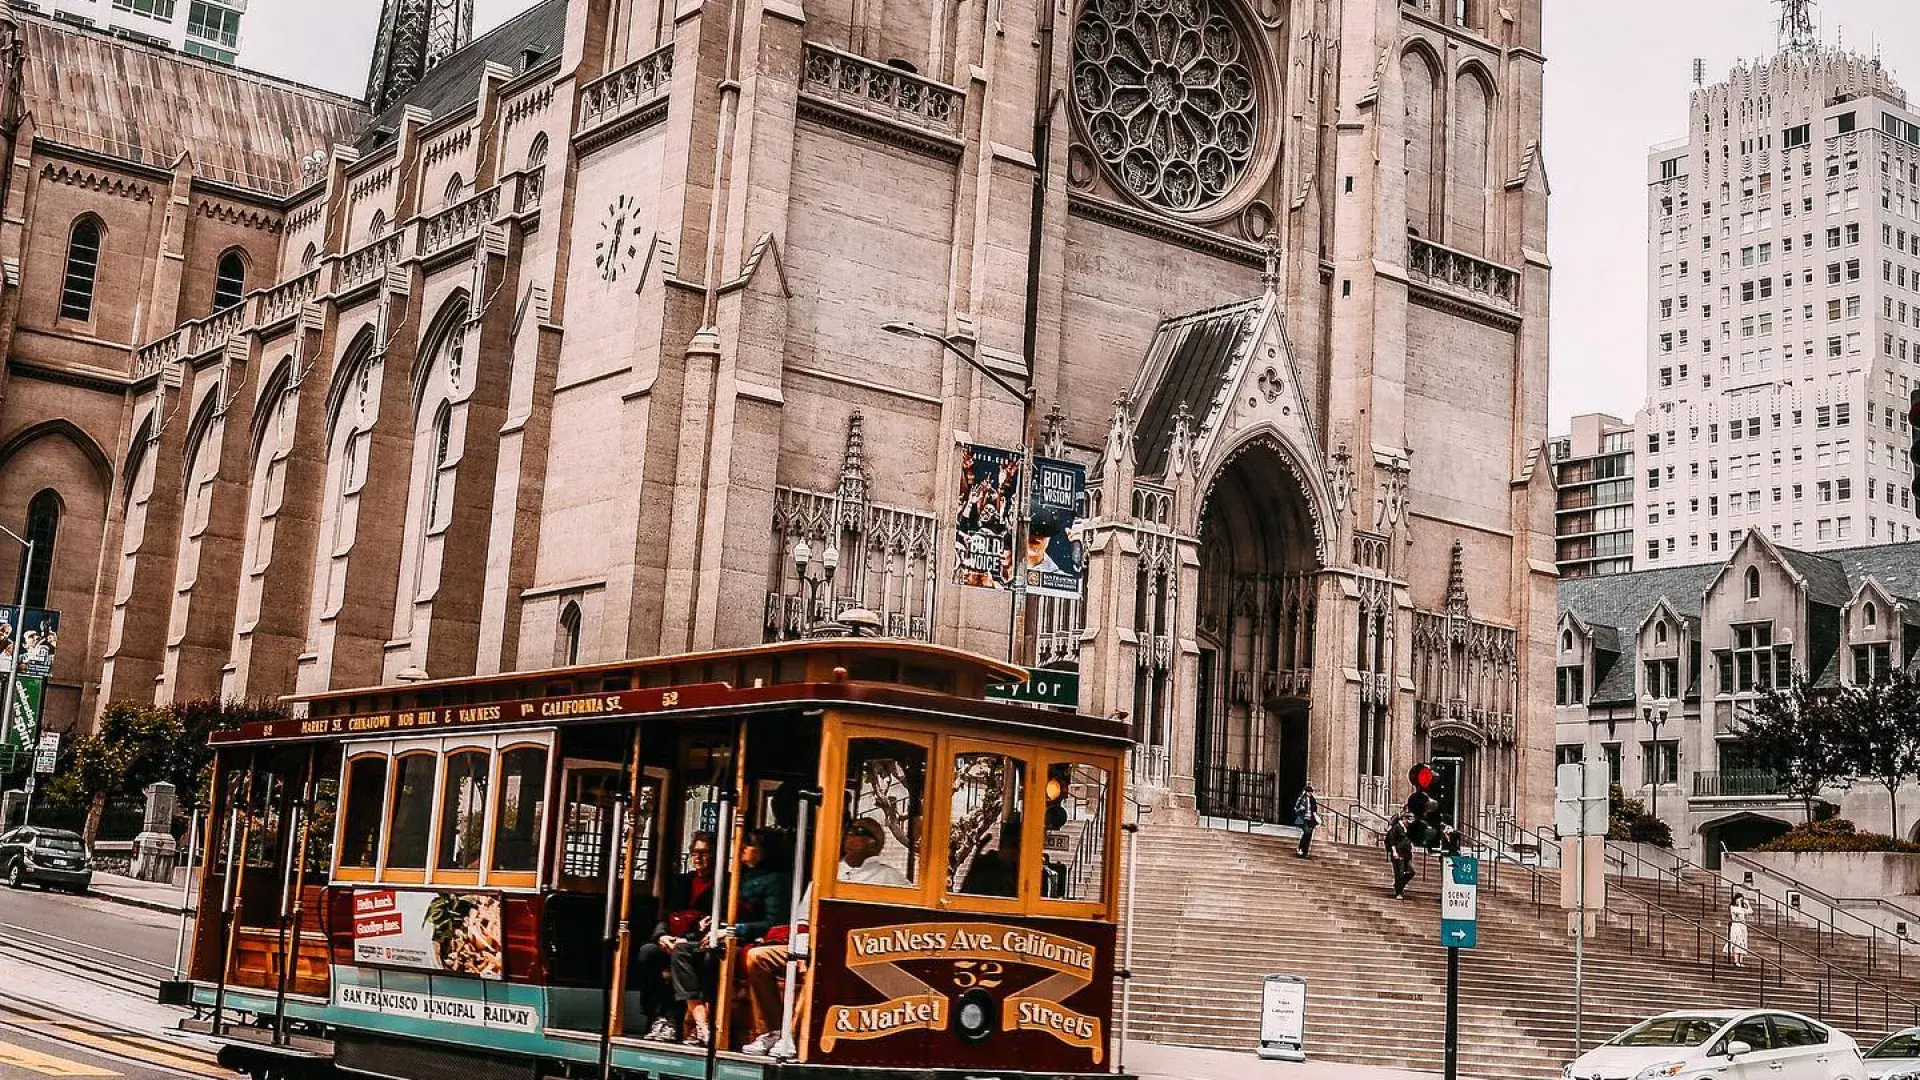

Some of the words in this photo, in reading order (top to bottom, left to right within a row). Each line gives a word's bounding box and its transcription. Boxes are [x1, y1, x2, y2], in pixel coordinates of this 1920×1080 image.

[1043, 471, 1072, 491] BOLD
[1044, 488, 1071, 506] VISION
[970, 535, 1002, 555] BOLD
[971, 553, 1000, 571] VOICE
[302, 720, 328, 734] MARKET
[348, 716, 391, 731] CHINATOWN
[398, 712, 414, 727] NOB
[418, 711, 438, 725] HILL
[542, 697, 604, 717] CALIFORNIA
[662, 691, 678, 707] 52
[13, 716, 36, 752] spirit
[1447, 891, 1471, 900] SCENIC
[1448, 900, 1469, 908] DRIVE
[1002, 931, 1092, 970] California
[952, 961, 1003, 988] 52
[342, 988, 362, 1004] SAN
[364, 991, 418, 1012] FRANCISCO
[424, 1000, 476, 1019] MUNICIPAL
[484, 1006, 530, 1026] RAILWAY
[836, 1009, 858, 1031] &
[858, 1000, 940, 1030] Market
[1018, 1001, 1093, 1039] Streets
